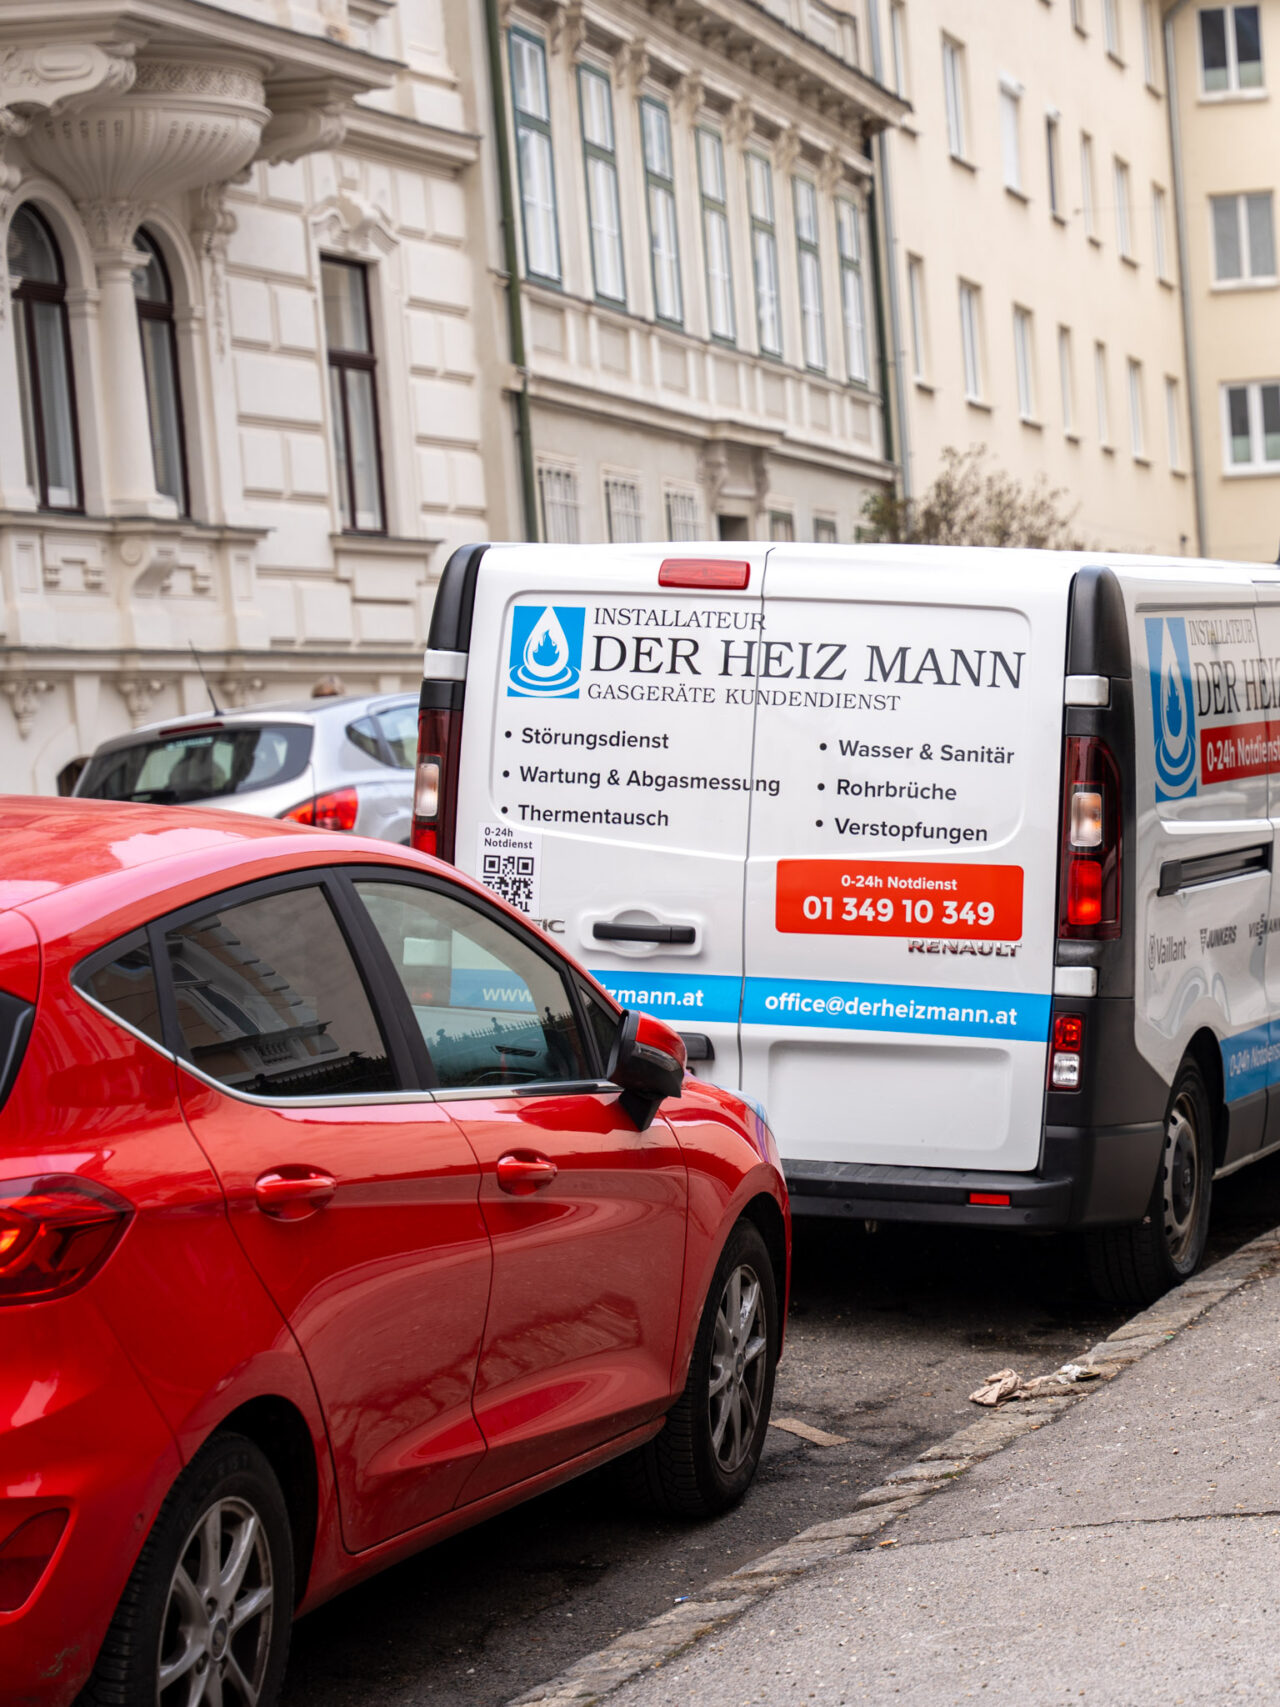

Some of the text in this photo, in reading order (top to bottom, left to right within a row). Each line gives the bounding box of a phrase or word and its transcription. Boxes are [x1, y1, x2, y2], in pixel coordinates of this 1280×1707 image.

[593, 607, 767, 630] INSTALLATEUR
[1188, 618, 1255, 646] INSTALLATEUR
[590, 635, 1026, 689] DER HEIZ MANN
[587, 682, 901, 711] GASGERÄTE KUNDENDIENST
[1194, 660, 1241, 717] DER
[521, 727, 669, 750] Störungsdienst
[838, 739, 1015, 764] Wasser & Sanitär
[1207, 738, 1236, 772] 0-24h
[519, 766, 781, 797] Wartung & Abgasmessung
[836, 779, 957, 801] Rohrbrüche
[518, 804, 669, 827] Thermentausch
[484, 827, 513, 837] 0-24h
[484, 838, 533, 850] Notdienst
[834, 818, 988, 845] Verstopfungen
[841, 875, 958, 891] 0-24h Notdienst
[803, 896, 995, 926] 01 349 10 349
[908, 938, 1022, 958] RENAULT
[1156, 935, 1187, 965] Vaillant
[1206, 925, 1237, 949] JUNKERS
[765, 992, 1018, 1026] office@derheizmann.at
